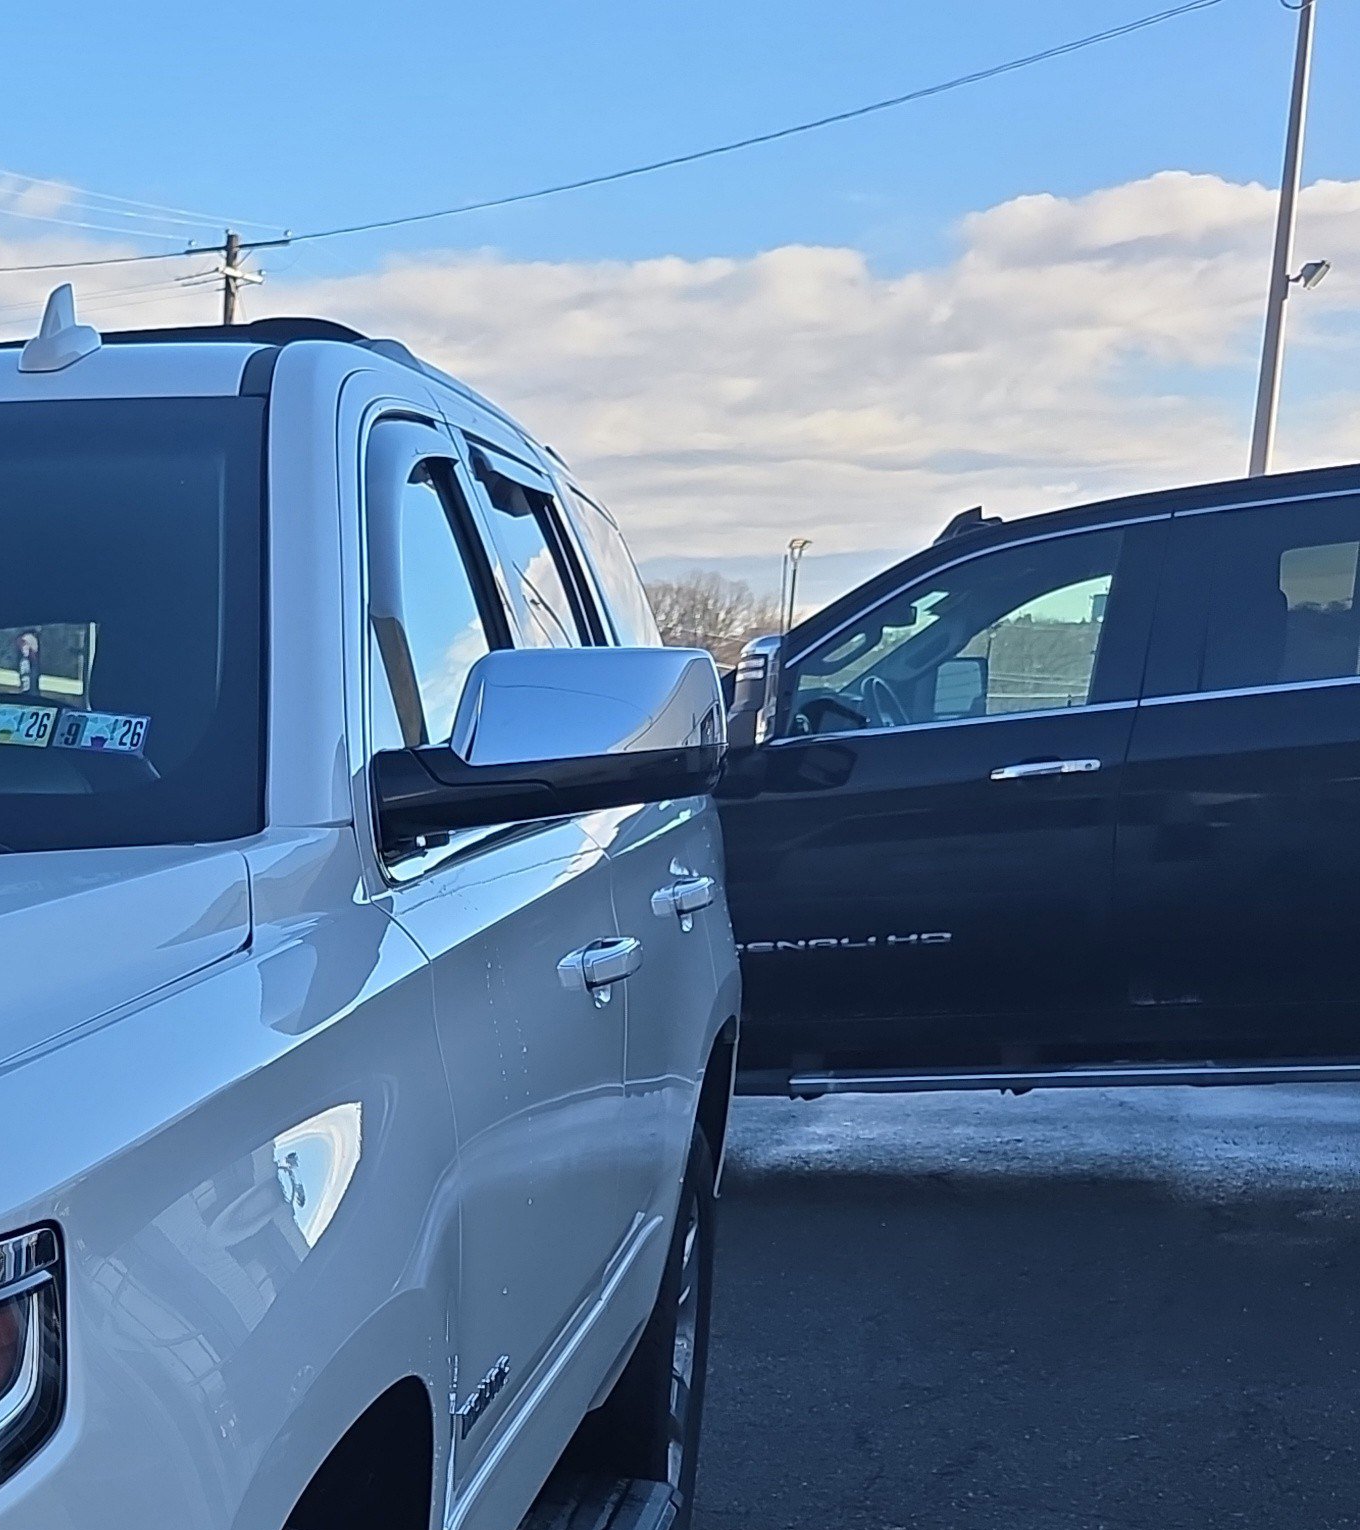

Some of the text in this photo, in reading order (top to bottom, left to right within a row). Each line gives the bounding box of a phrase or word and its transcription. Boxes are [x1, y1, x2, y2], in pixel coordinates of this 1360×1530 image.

[24, 711, 51, 740] 26
[118, 719, 144, 748] 26
[736, 936, 877, 952] ENALI
